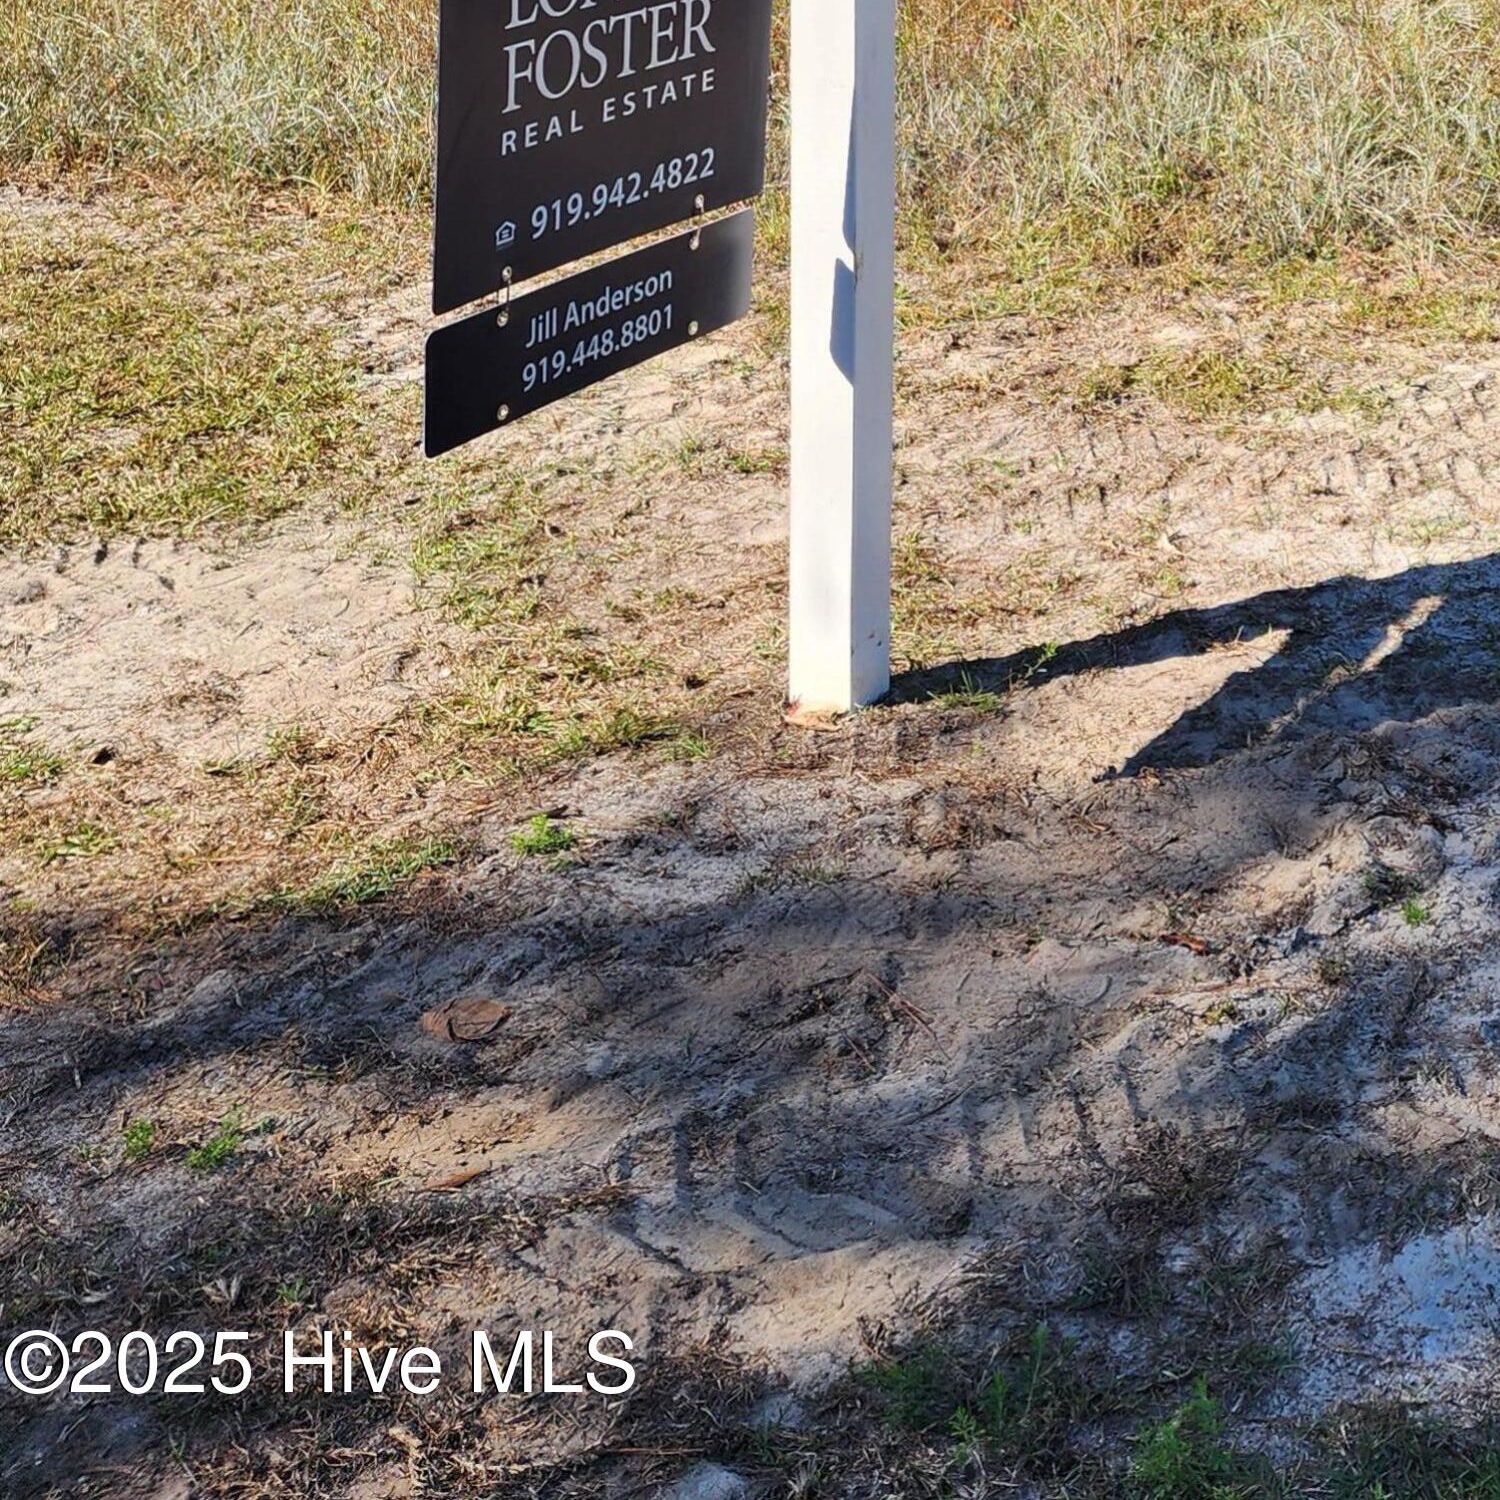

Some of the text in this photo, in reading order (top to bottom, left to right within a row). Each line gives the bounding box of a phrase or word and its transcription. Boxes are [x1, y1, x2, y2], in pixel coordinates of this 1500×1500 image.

[501, 68, 716, 156] REAL ESTATE
[531, 147, 715, 239] 919.942.4822
[522, 304, 673, 393] 919.448.8801
[525, 269, 673, 348] Jill Anderson
